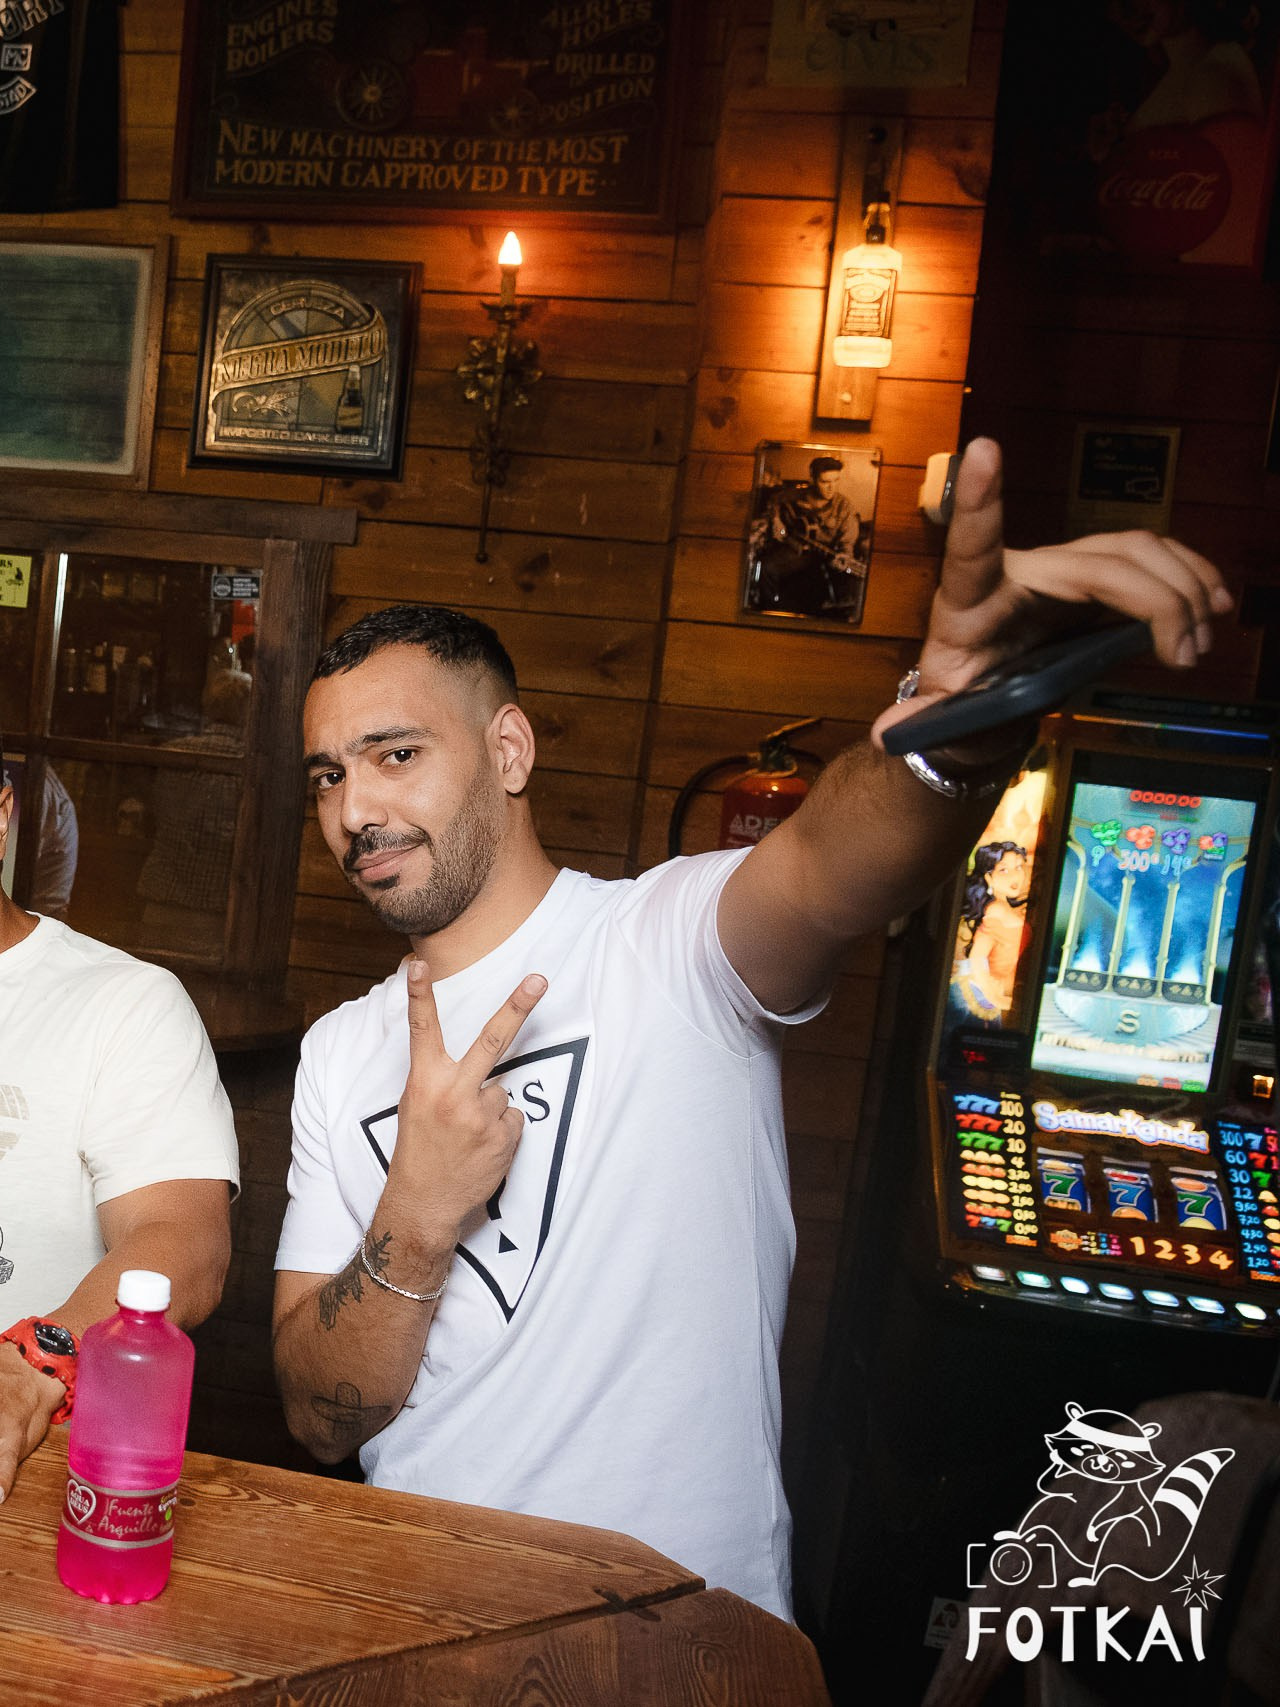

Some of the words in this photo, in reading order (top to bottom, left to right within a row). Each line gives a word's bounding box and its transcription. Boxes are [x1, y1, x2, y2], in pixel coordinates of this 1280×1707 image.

[226, 19, 336, 71] BOILERS
[543, 77, 655, 122] POSITION
[218, 118, 282, 156] NEW
[288, 131, 446, 161] MACHINERY
[453, 138, 486, 162] OF
[487, 138, 543, 163] THE
[544, 135, 628, 165] MOST
[215, 159, 334, 188] MODERN
[216, 349, 292, 386] NEGRA
[294, 329, 384, 370] MODELO
[1000, 1101, 1024, 1117] 100
[1003, 1119, 1025, 1135] 20
[1220, 1131, 1243, 1147] 300
[1006, 1138, 1026, 1154] 10
[1225, 1151, 1246, 1165] 60
[1010, 1156, 1025, 1169] 4
[1043, 1171, 1080, 1197] 7
[1229, 1169, 1250, 1184] 30
[1108, 1181, 1146, 1207] 7
[1176, 1190, 1214, 1217] 7
[1232, 1186, 1254, 1200] 12
[1130, 1236, 1145, 1256] 1
[1153, 1239, 1177, 1261] 2
[1181, 1244, 1201, 1265] 3
[1208, 1250, 1234, 1271] 4
